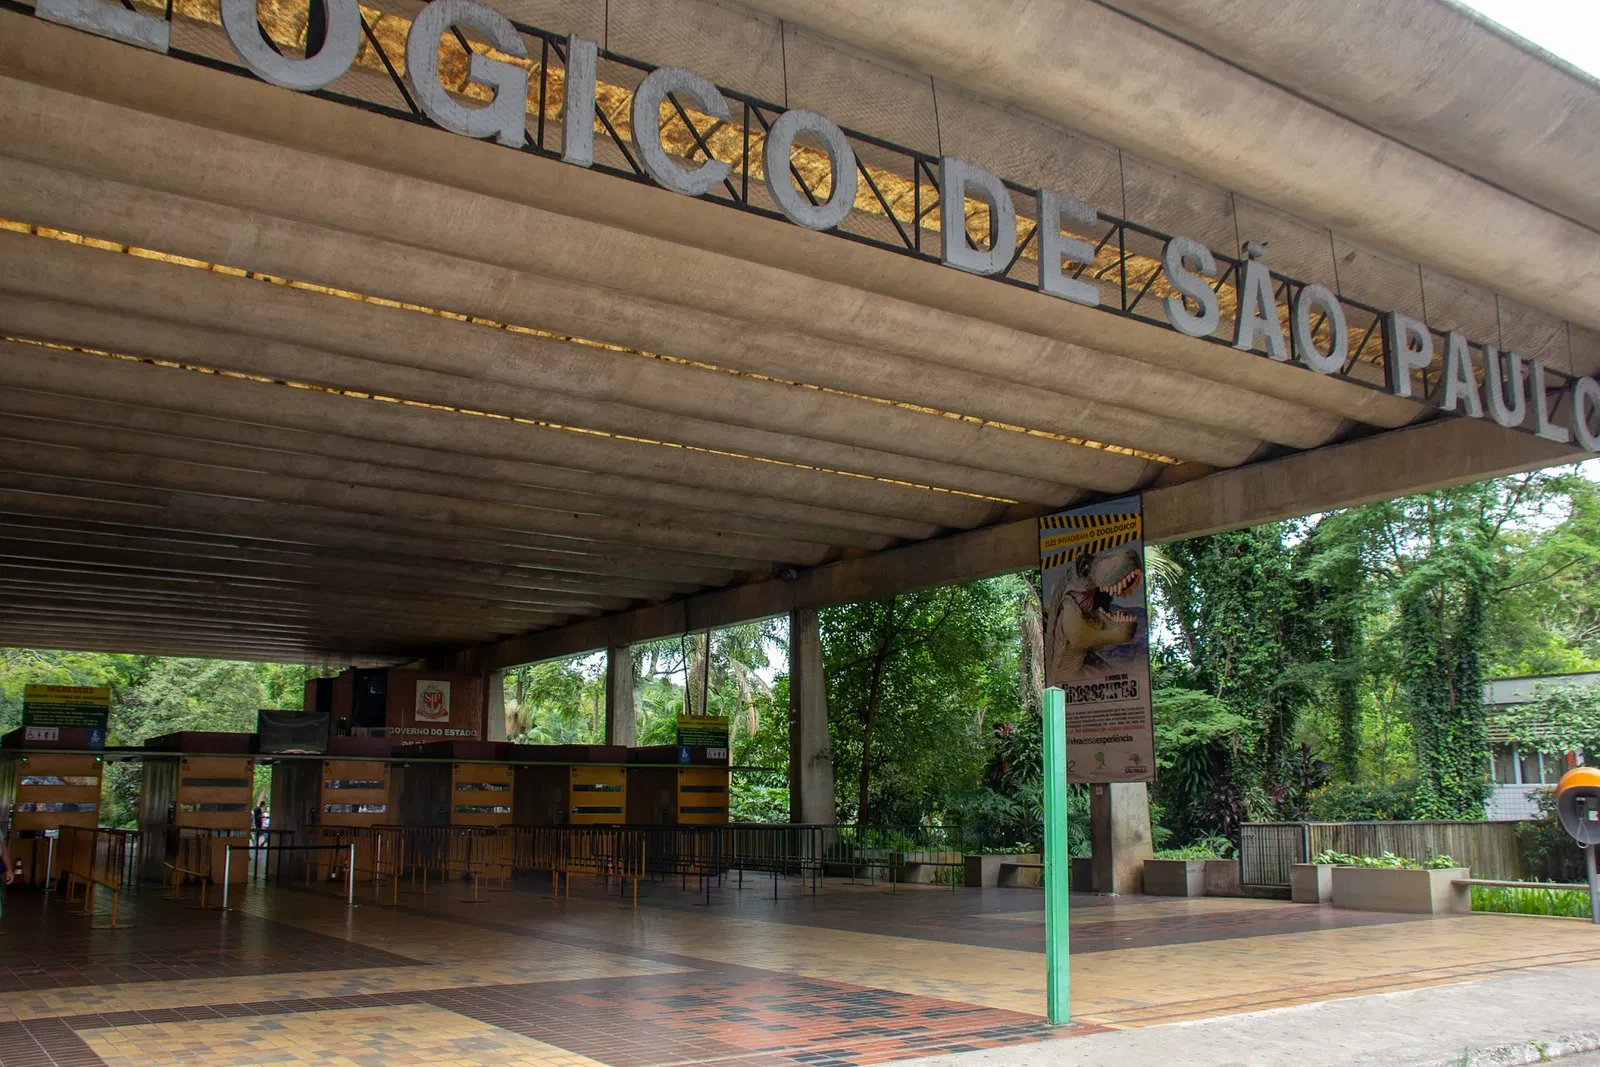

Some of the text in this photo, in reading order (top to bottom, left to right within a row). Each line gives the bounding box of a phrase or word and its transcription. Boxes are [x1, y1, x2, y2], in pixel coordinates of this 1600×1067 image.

[35, 0, 1600, 453] OGICO DE SÃO PAULO
[1044, 540, 1057, 548] ELES
[1057, 533, 1089, 544] INVADIRAM
[1089, 530, 1095, 538] O
[388, 727, 428, 735] GOVERNO
[444, 729, 477, 737] ESTADO
